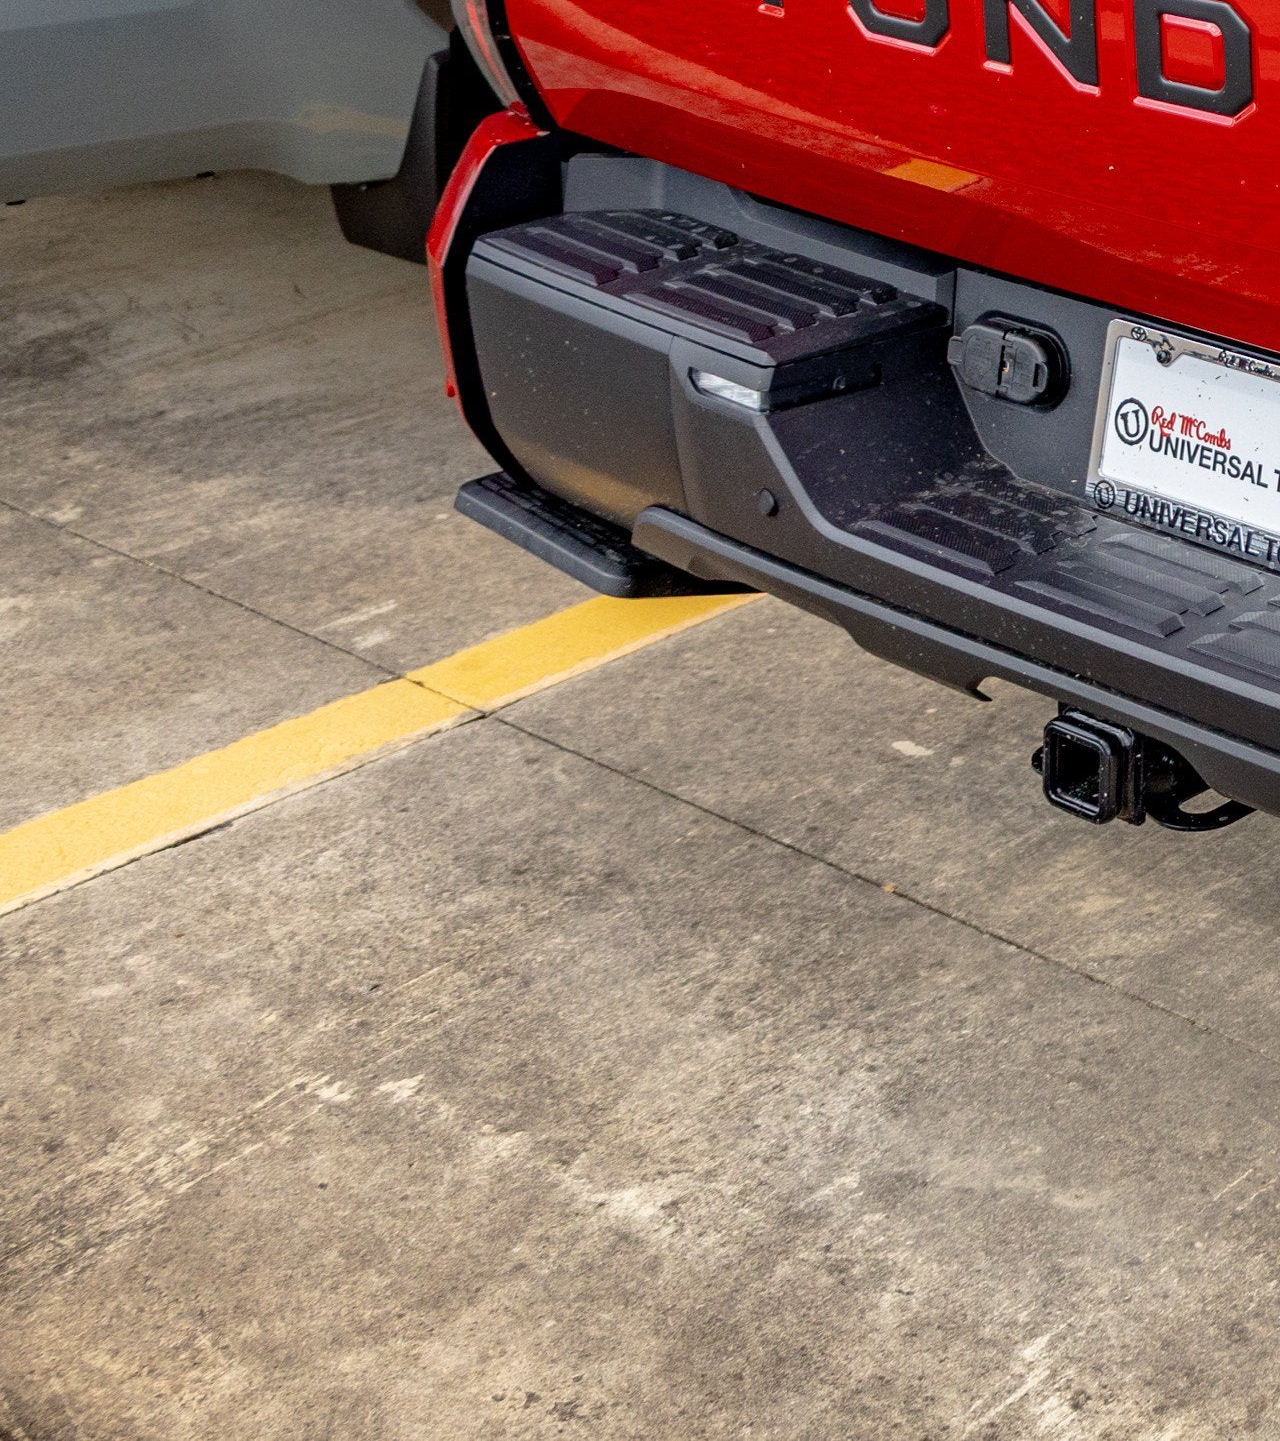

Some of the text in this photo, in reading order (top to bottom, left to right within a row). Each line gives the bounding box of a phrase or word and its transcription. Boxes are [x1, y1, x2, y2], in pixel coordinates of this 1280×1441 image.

[1151, 405, 1231, 450] Red McCombs
[1149, 429, 1268, 488] UNIVERSAL
[1123, 489, 1260, 557] UNIVERSAL
